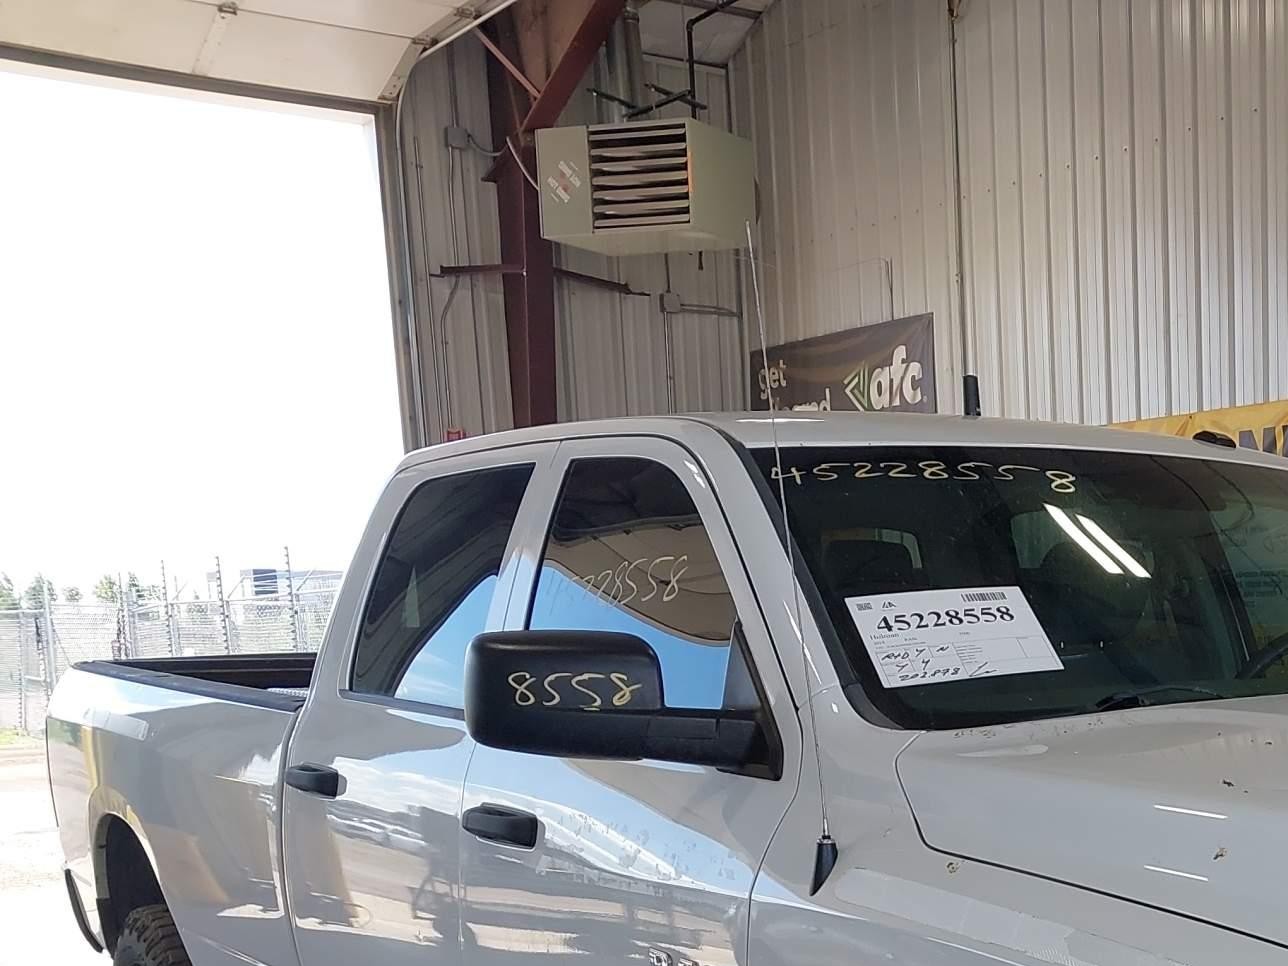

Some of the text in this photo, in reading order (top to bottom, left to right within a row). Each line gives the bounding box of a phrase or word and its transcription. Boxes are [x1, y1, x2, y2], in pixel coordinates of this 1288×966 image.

[758, 360, 786, 399] get
[870, 345, 922, 410] afc
[771, 461, 1076, 492] 45228558
[876, 605, 1015, 632] 45228558
[507, 671, 643, 707] 8558
